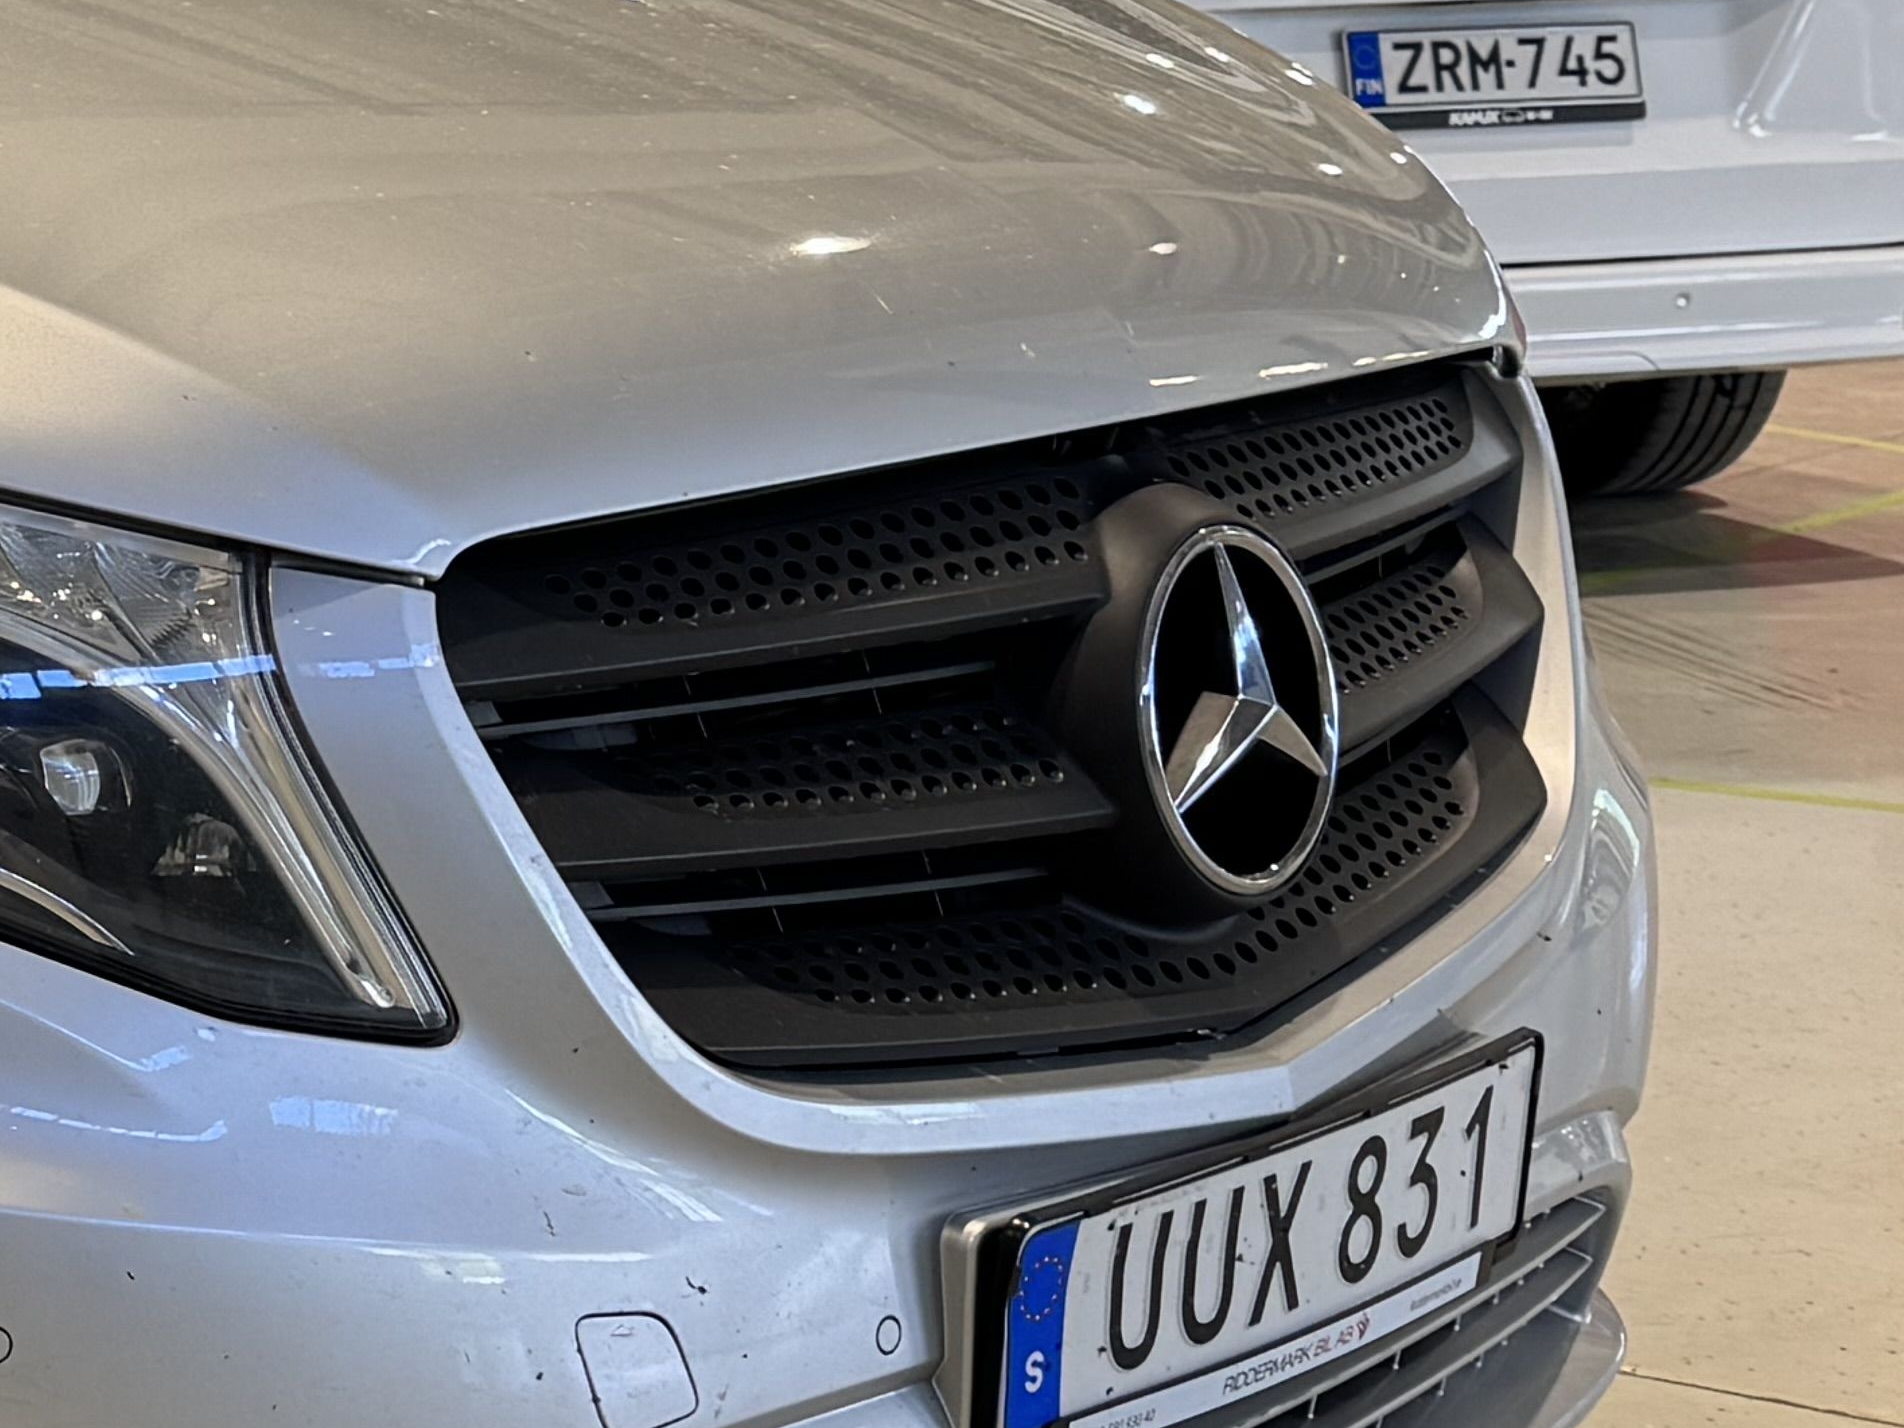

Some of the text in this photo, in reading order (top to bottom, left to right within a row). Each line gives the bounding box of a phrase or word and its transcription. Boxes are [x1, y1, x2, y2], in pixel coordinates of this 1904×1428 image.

[1355, 78, 1385, 96] FIN
[1392, 34, 1626, 96] ZRM-745
[1107, 1083, 1496, 1372] UUX 831
[1023, 1349, 1045, 1394] S
